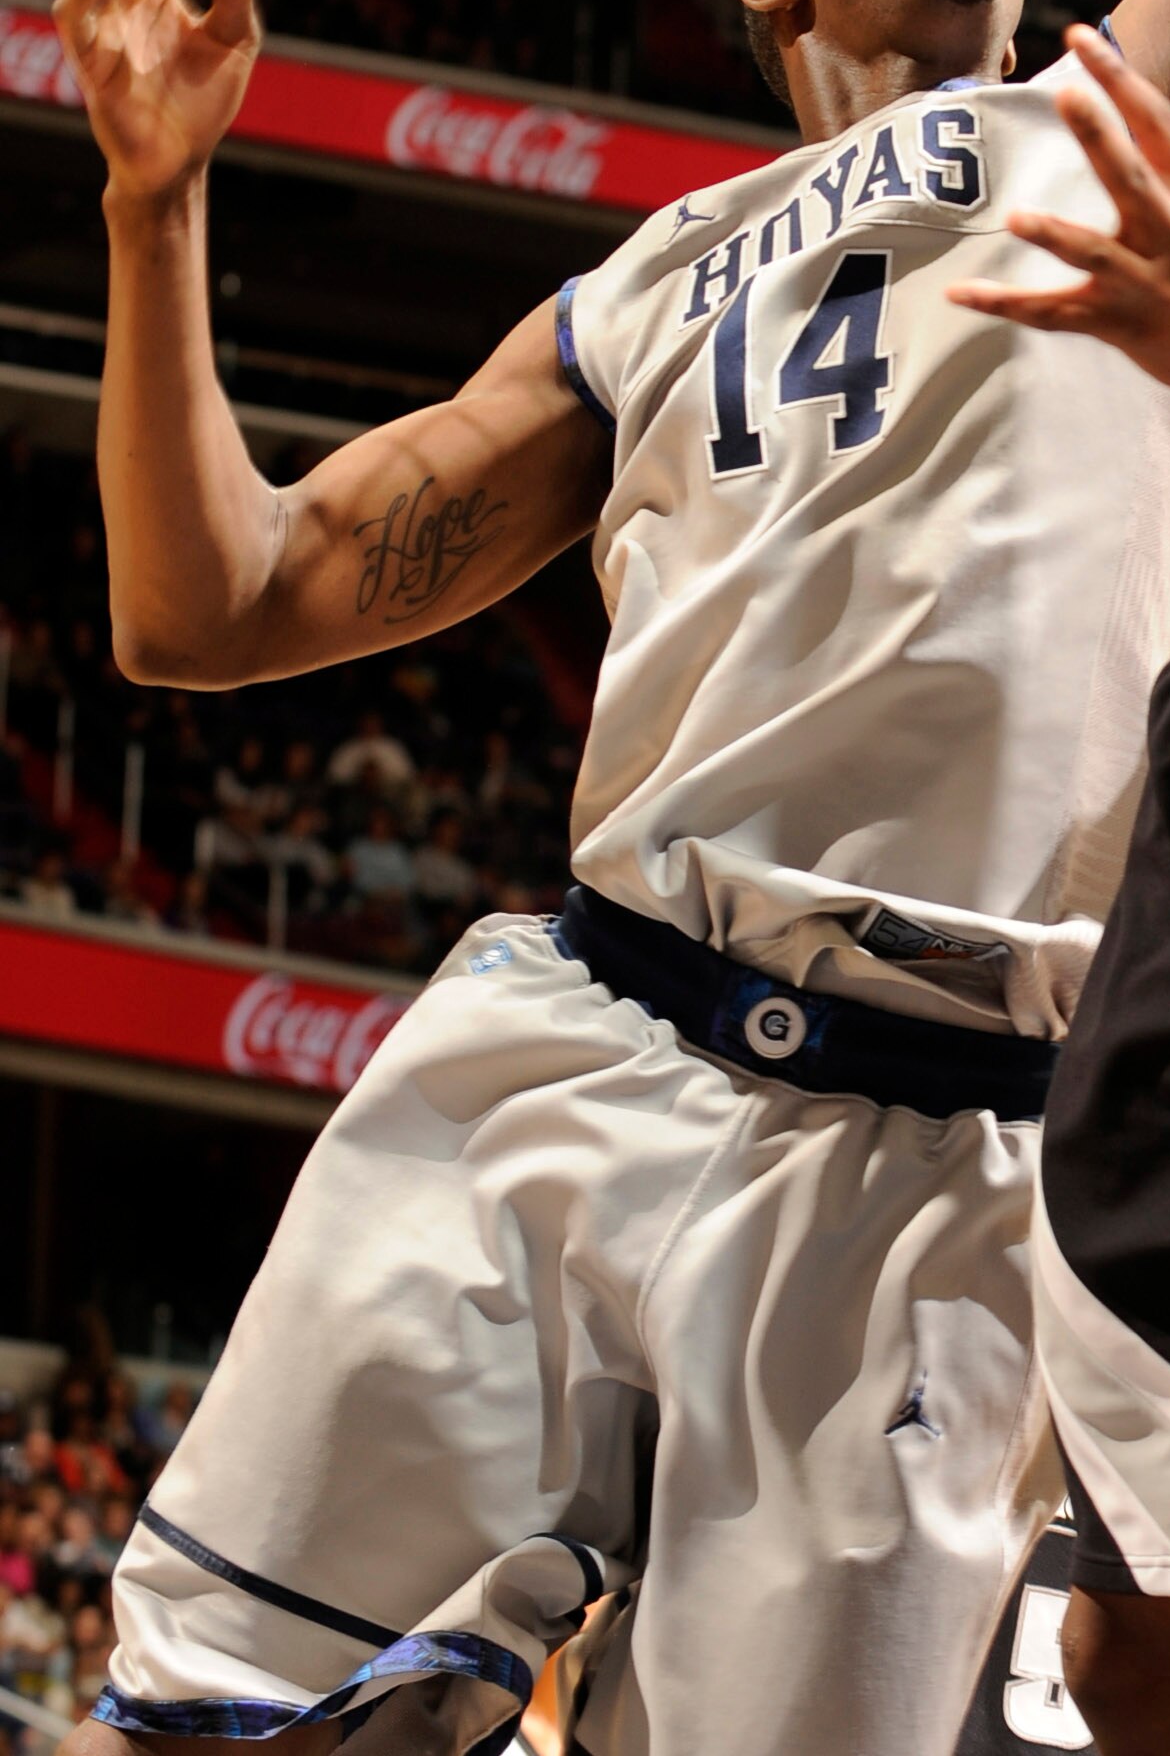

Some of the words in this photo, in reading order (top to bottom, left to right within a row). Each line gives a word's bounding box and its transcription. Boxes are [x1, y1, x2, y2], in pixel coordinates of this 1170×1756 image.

[679, 103, 988, 332] HOYAS
[705, 248, 898, 481] 14
[352, 475, 509, 617] Hope
[759, 1009, 791, 1041] G
